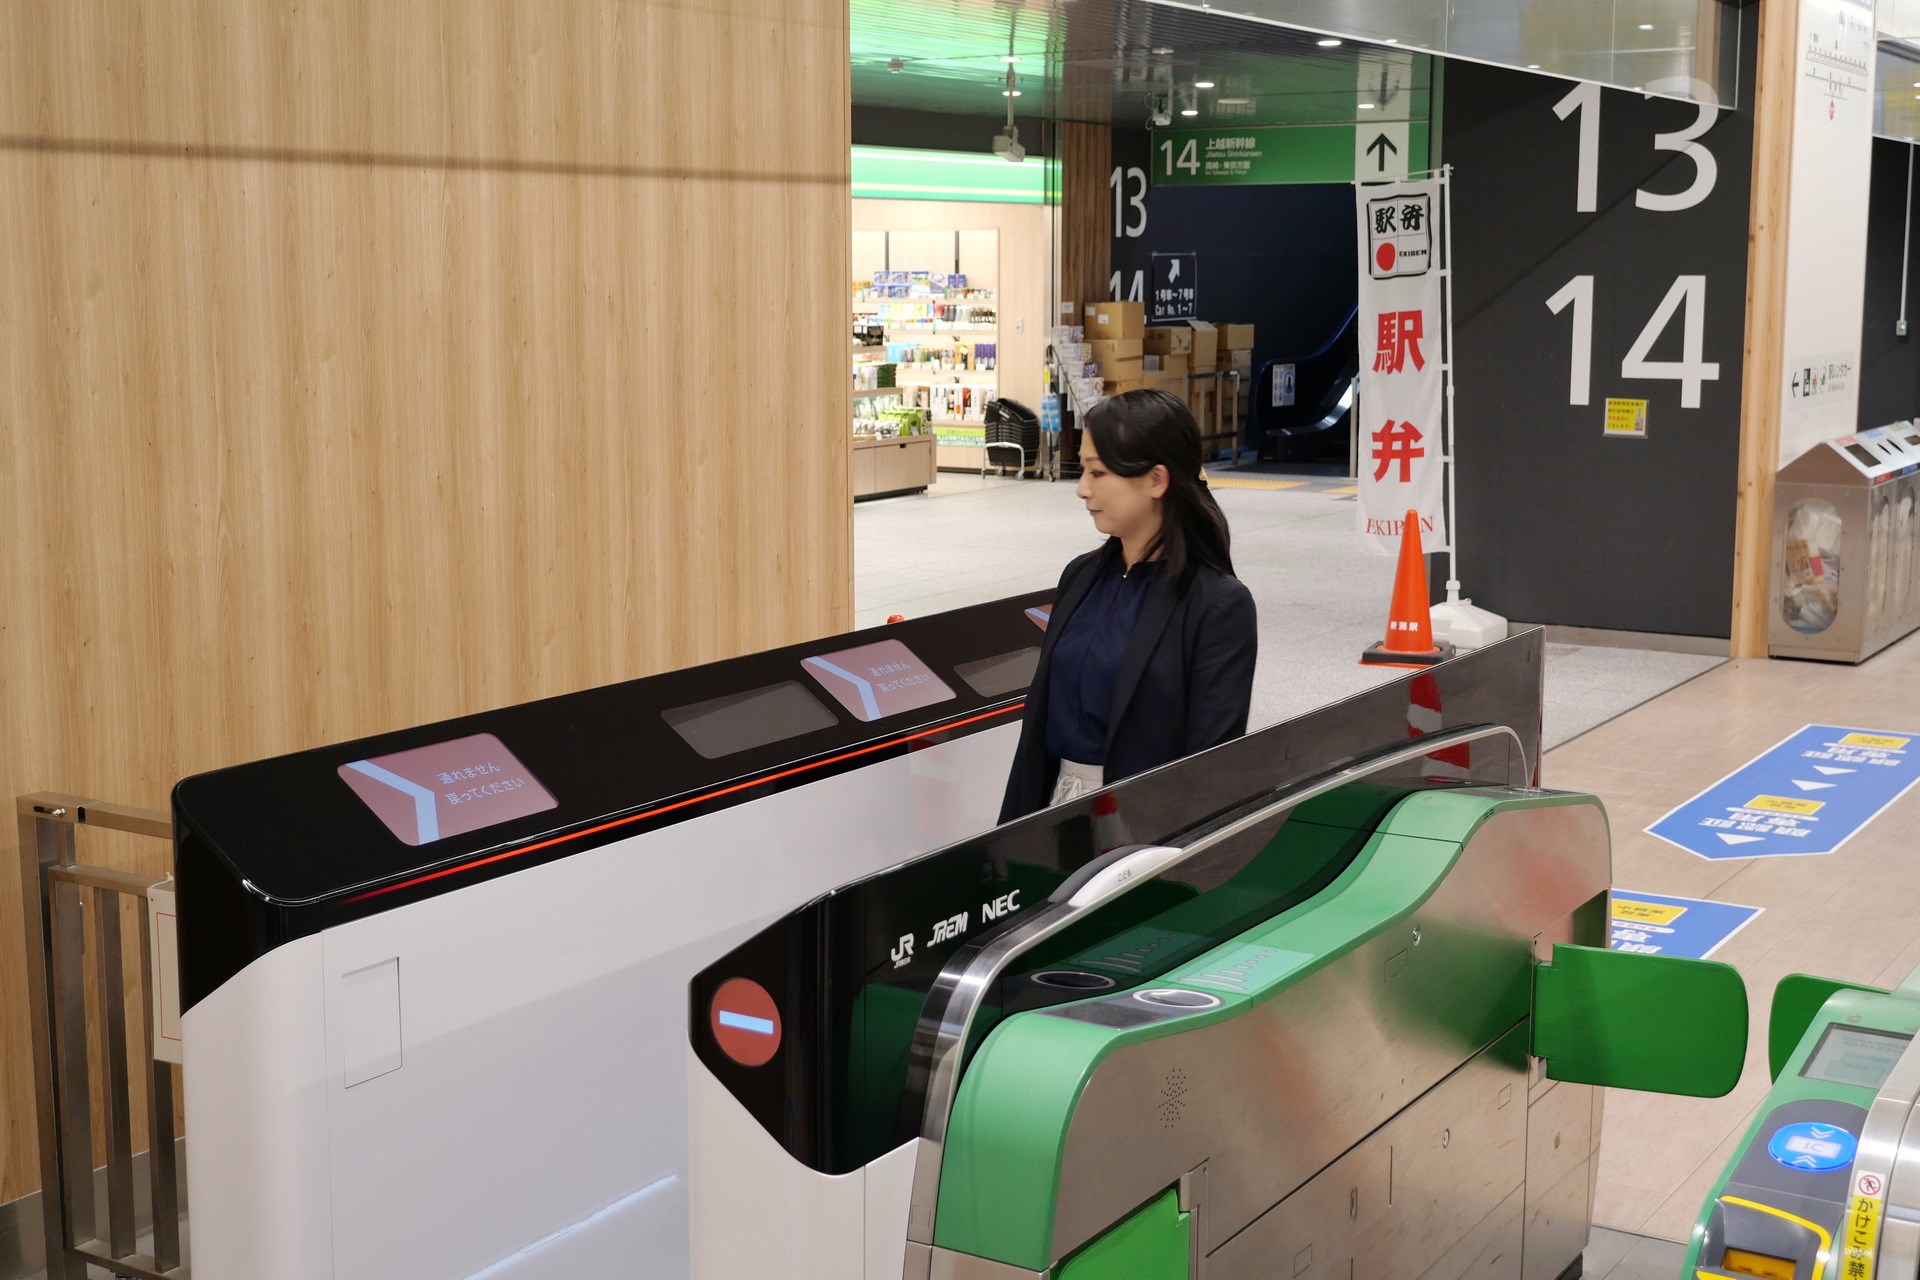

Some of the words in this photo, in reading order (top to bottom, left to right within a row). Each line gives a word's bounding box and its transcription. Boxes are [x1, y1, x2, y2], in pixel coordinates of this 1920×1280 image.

[1159, 138, 1201, 176] 14
[1552, 77, 1718, 212] 13
[1110, 166, 1147, 238] 13
[1399, 249, 1428, 258] EKIBEN
[1154, 304, 1166, 316] Car
[1545, 275, 1719, 409] 14
[1371, 309, 1426, 484] 駅弁
[1365, 515, 1435, 536] EKIBN
[867, 661, 911, 677] 通れません
[877, 673, 929, 693] 戻ってください
[437, 762, 501, 785] 通れません
[444, 777, 526, 806] 戻ってください
[890, 932, 915, 962] JR
[982, 889, 1021, 924] NEC
[1804, 1142, 1825, 1152] IC
[1847, 1197, 1874, 1280] かけこみ禁
